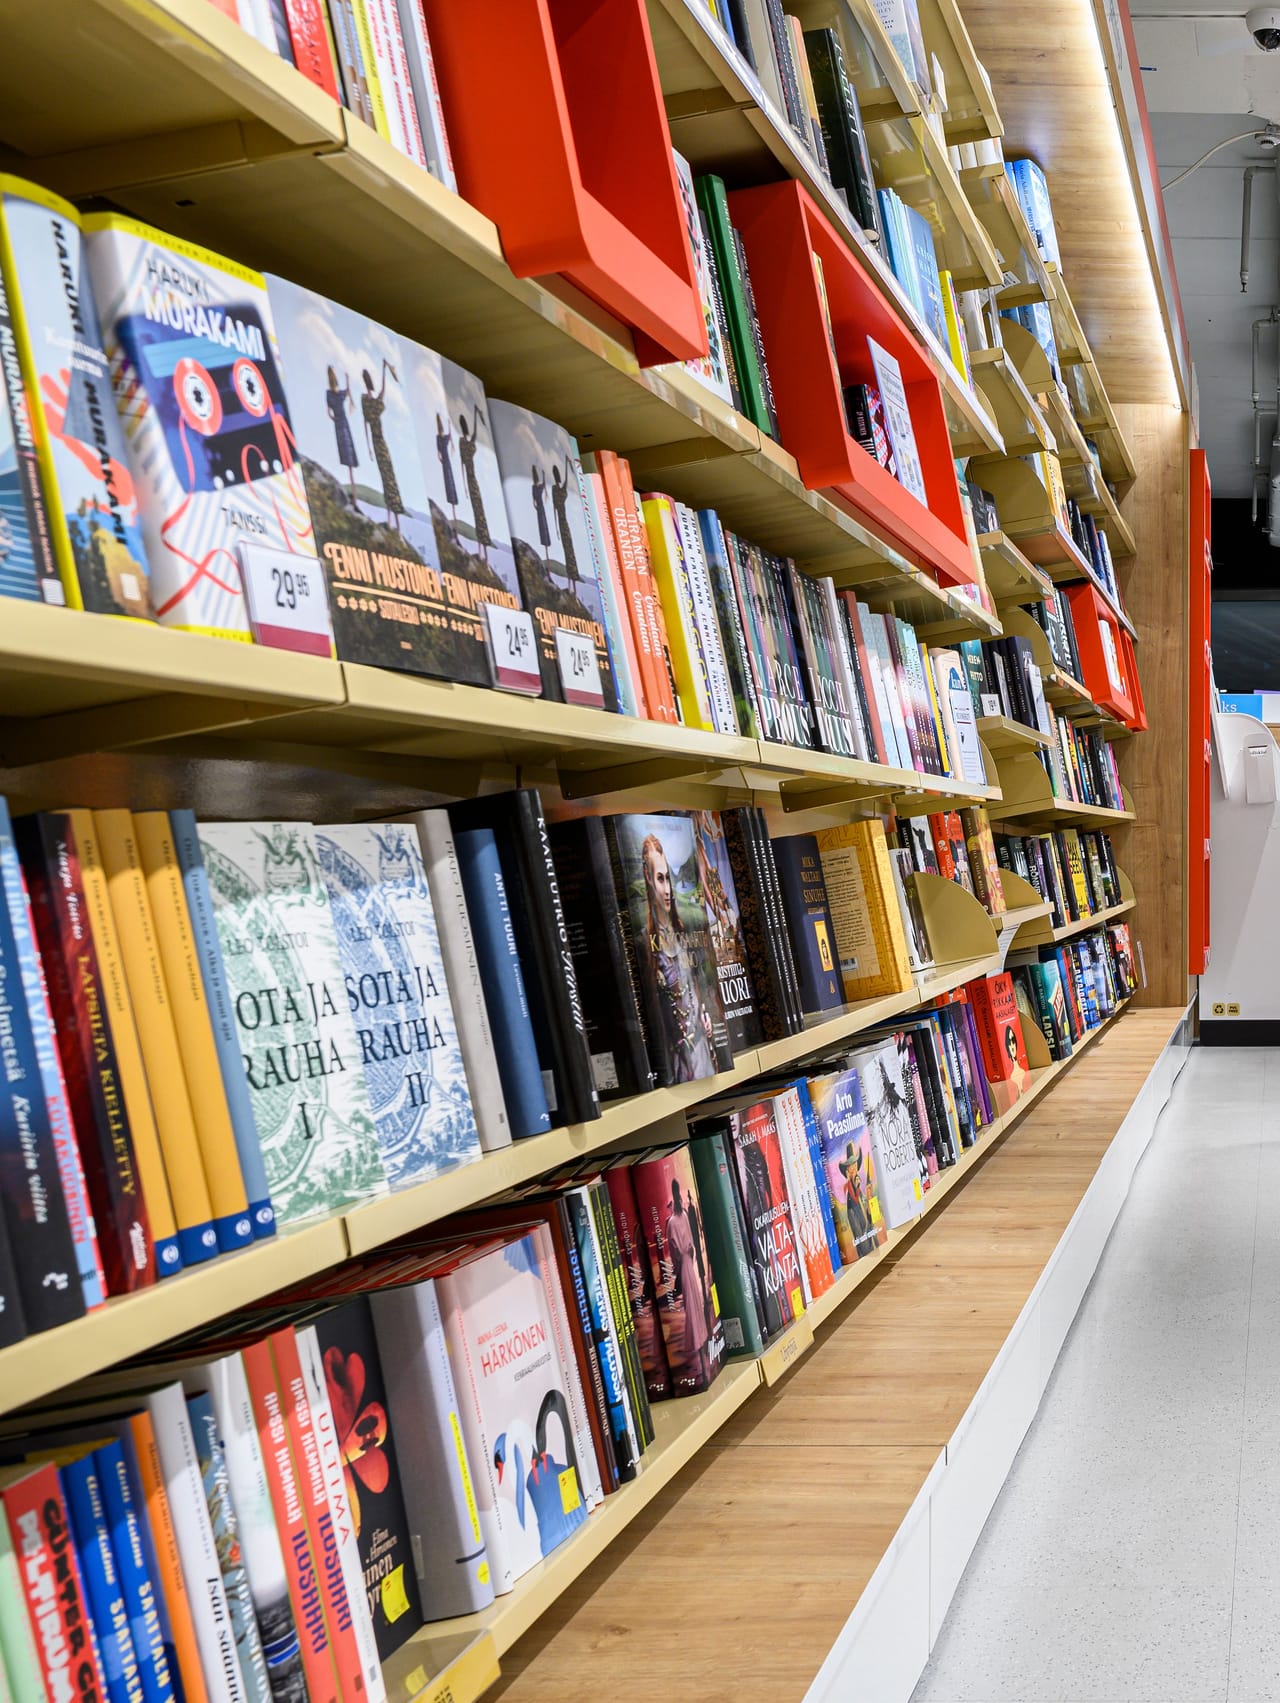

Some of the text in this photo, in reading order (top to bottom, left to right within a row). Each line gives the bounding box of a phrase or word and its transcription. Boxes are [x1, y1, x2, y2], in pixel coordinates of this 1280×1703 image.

[146, 256, 210, 303] HARUKI
[143, 288, 266, 362] MURAKAMI
[614, 507, 635, 571] ORANEN
[626, 513, 648, 577] ORANEN
[272, 568, 296, 609] 29
[374, 554, 442, 600] MUSTONEN
[536, 817, 556, 877] KAARI
[549, 881, 569, 943] UTRIO
[494, 872, 517, 955] ANTTI TUURI
[236, 981, 339, 1031] OTA JA
[345, 965, 440, 1013] SOTA JA
[360, 1015, 448, 1064] RAUHA
[1042, 1015, 1056, 1049] LAPSI
[243, 1036, 347, 1090] RAUHA
[405, 1071, 428, 1108] II
[836, 1092, 853, 1113] Arto
[299, 1101, 314, 1140] I
[738, 1130, 756, 1149] SARAH
[761, 1121, 776, 1138] MAAS
[827, 1111, 866, 1140] Paasilinna
[881, 1116, 910, 1147] NORA
[884, 1149, 915, 1172] ROBERTS
[757, 1221, 794, 1260] VALTA-
[762, 1253, 800, 1298] KUNTA
[480, 1319, 546, 1378] HÄRKÖNEN
[318, 1412, 351, 1546] ULTIMA
